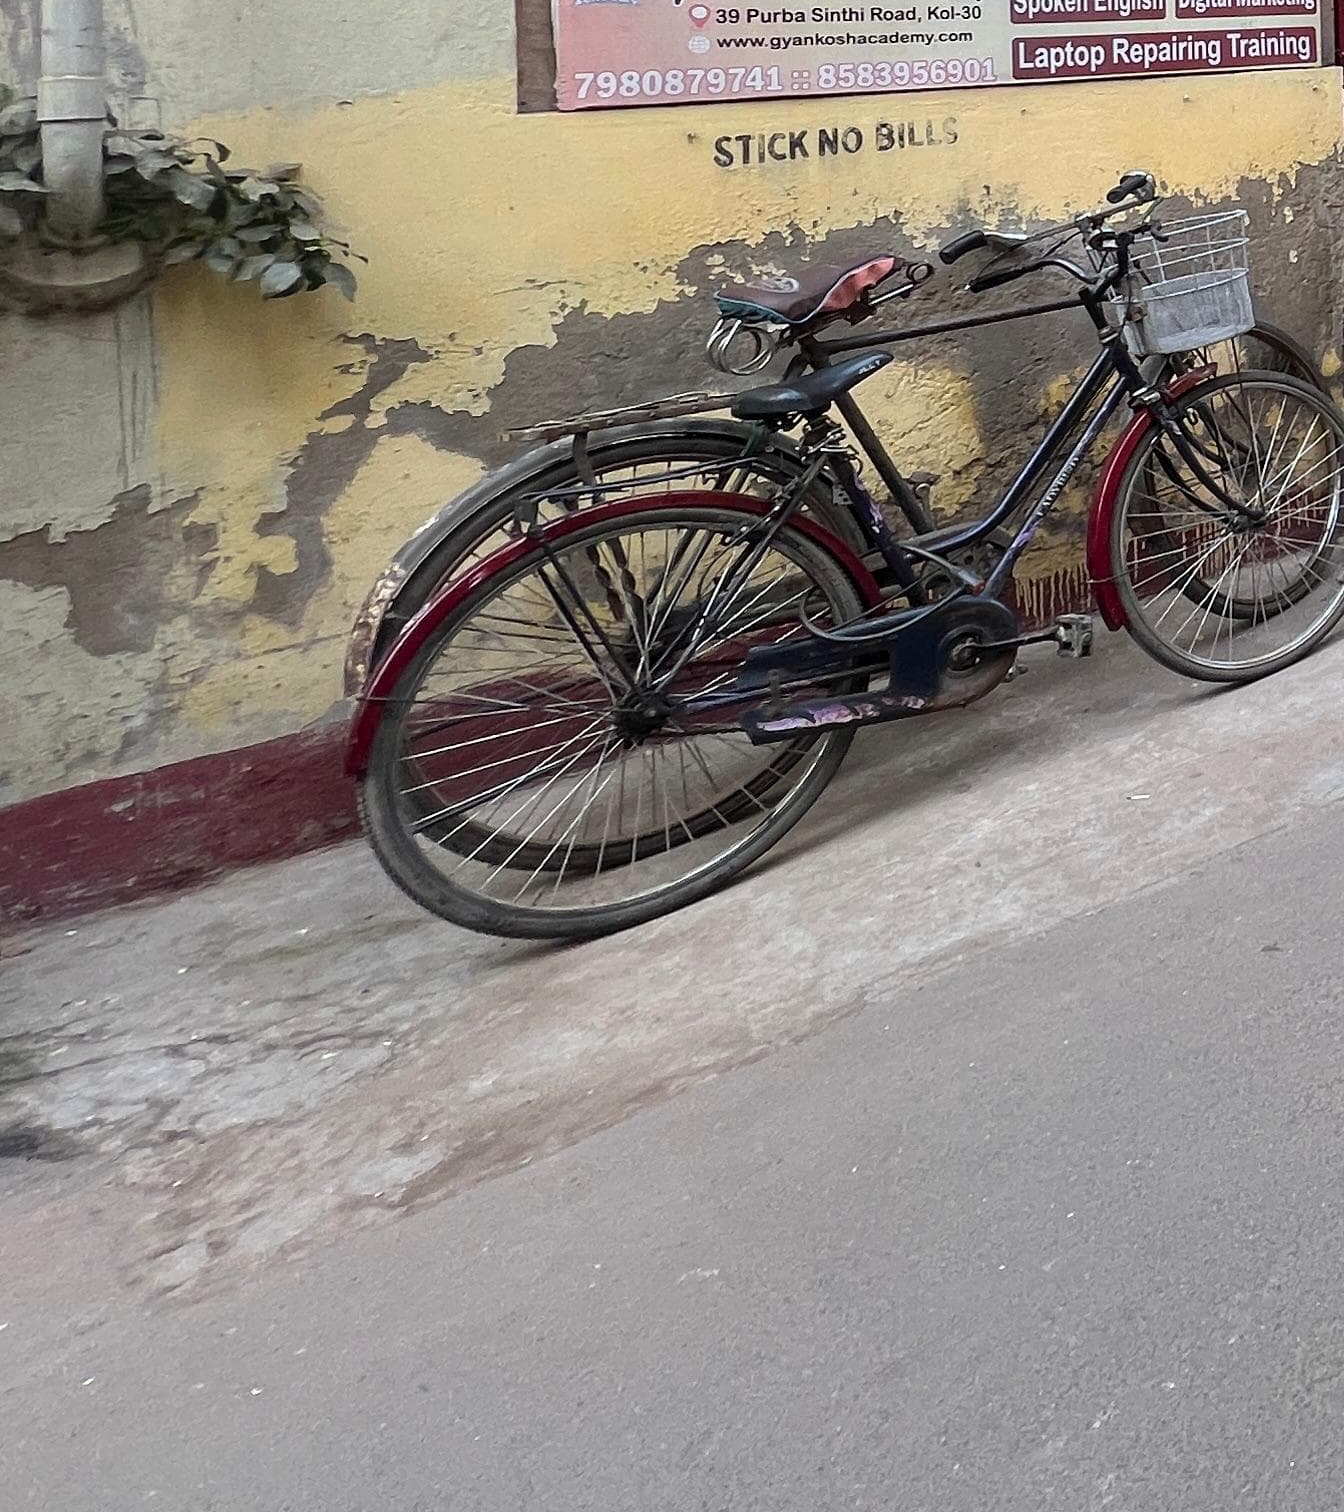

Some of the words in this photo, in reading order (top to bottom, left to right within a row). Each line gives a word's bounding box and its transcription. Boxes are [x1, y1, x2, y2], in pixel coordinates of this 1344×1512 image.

[747, 7, 806, 24] Purba
[811, 7, 865, 23] Sinthi
[1019, 42, 1105, 75] Laptop
[1112, 36, 1222, 66] Repairing
[1227, 30, 1311, 61] Training
[575, 66, 783, 100] 7980879741
[713, 129, 809, 168] STICK
[818, 126, 864, 156] NO
[875, 117, 958, 152] BILLS
